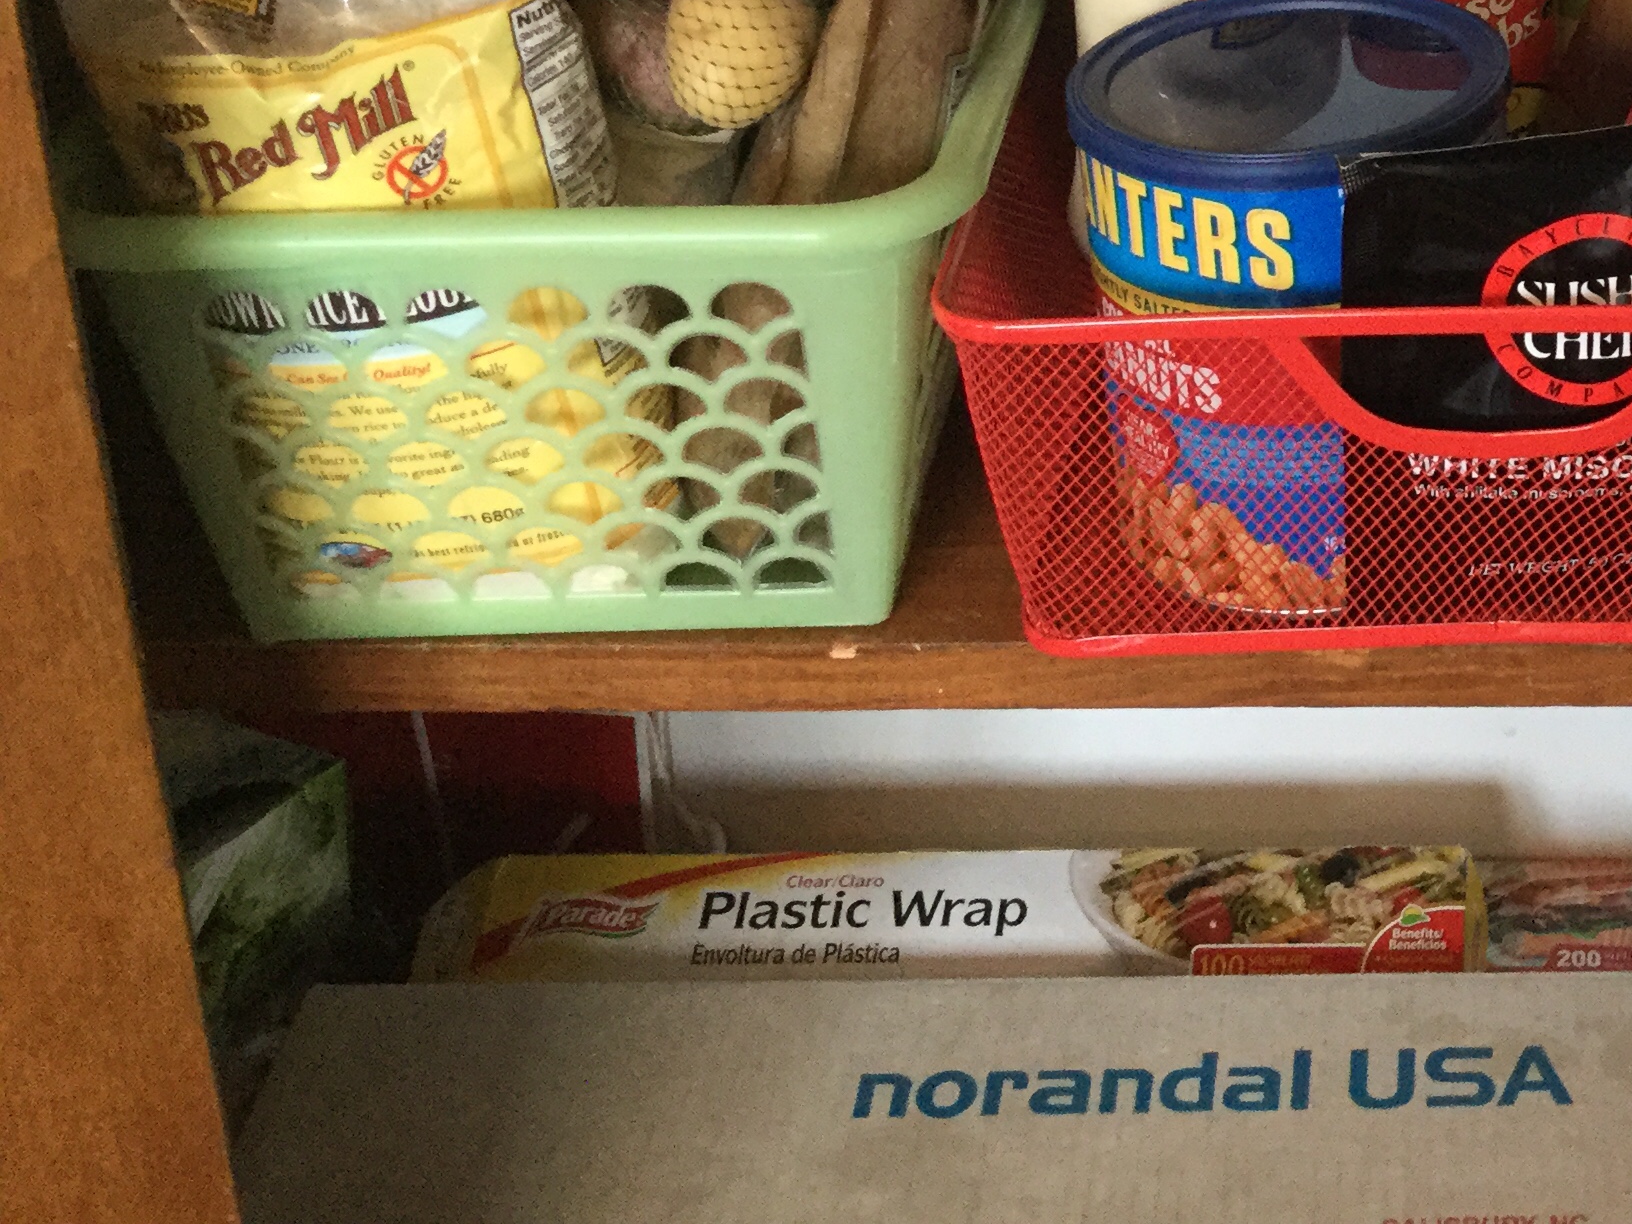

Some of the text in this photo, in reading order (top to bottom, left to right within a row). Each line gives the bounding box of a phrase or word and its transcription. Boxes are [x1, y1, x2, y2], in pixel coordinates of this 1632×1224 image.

[190, 63, 418, 208] Red Mill
[372, 132, 426, 182] GLUTEN
[421, 177, 463, 211] FREE
[373, 362, 432, 382] Quality!
[348, 404, 374, 417] We
[308, 454, 345, 466] Flour
[1408, 452, 1532, 480] WHITE
[411, 465, 447, 480] great
[1510, 558, 1578, 575] WEIGHT
[785, 874, 886, 890] Clear/Claro
[552, 903, 640, 928] Parade
[698, 888, 1029, 937] Plastic Wrap
[1391, 927, 1444, 940] Benefits/
[689, 940, 901, 966] Envoltura de Plástica
[1388, 939, 1448, 951] Beneficios
[1199, 952, 1246, 976] 100
[1557, 948, 1602, 969] 200
[851, 1042, 1575, 1120] norandal USA
